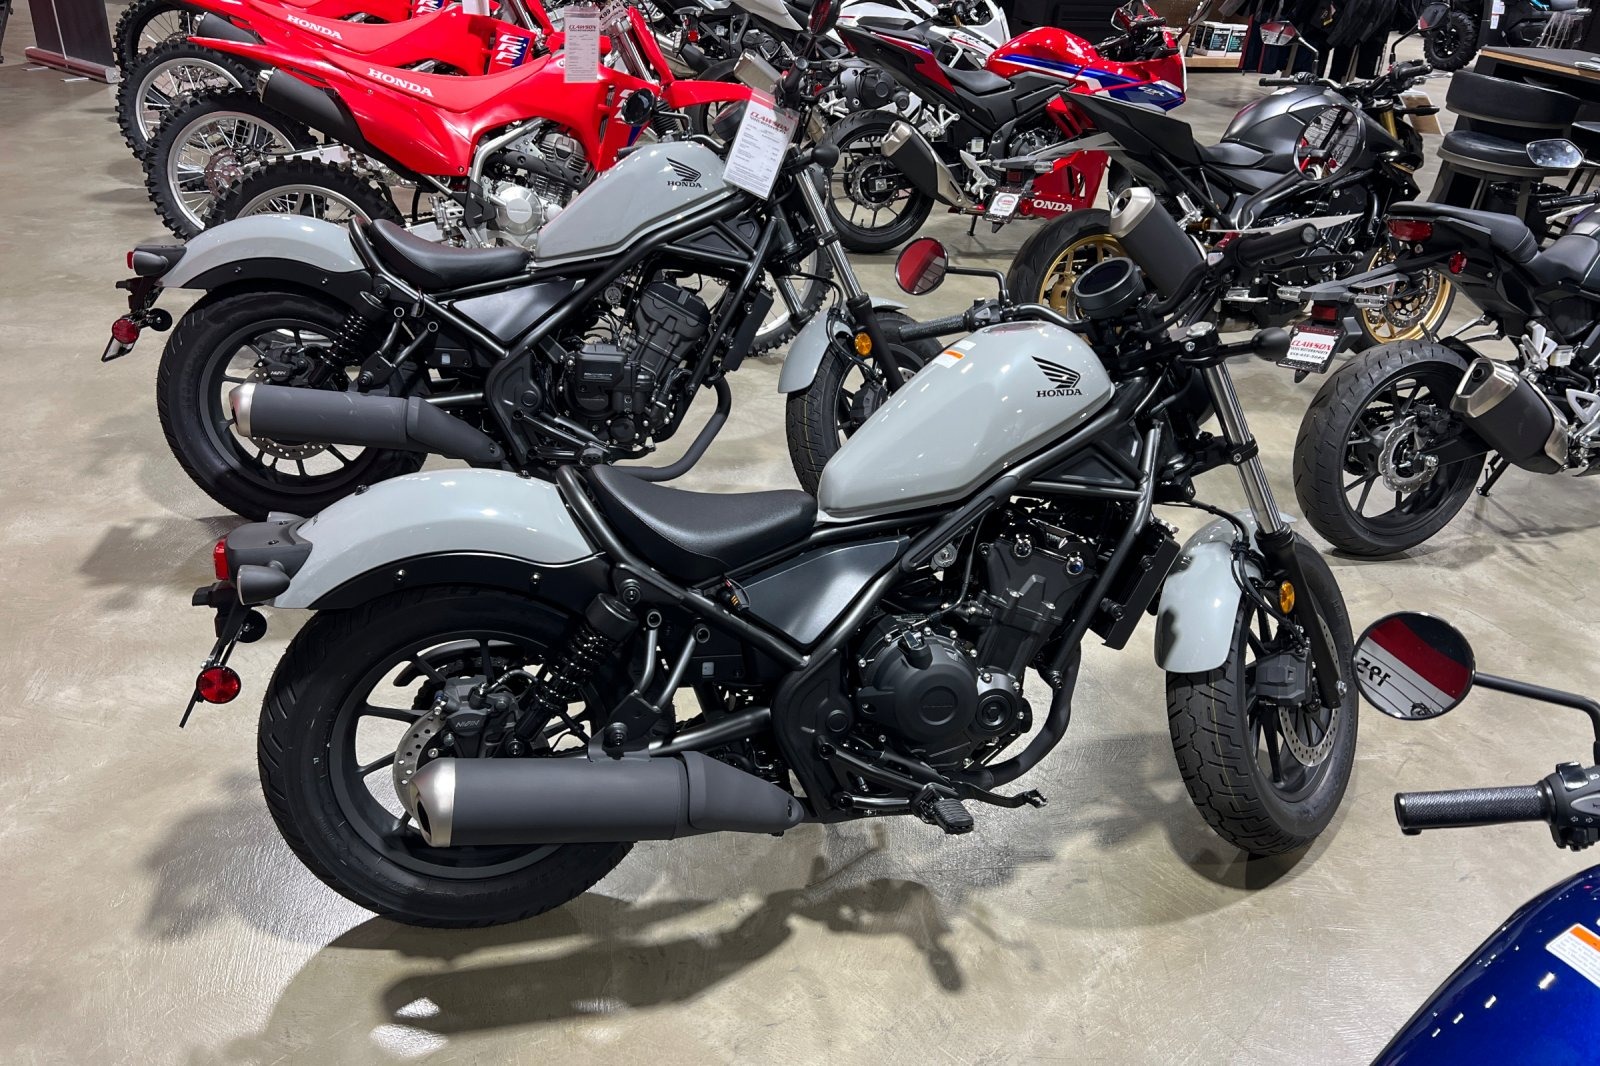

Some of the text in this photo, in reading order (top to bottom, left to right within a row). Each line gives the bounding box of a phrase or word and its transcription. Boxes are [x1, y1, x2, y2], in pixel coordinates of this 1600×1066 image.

[287, 14, 343, 40] HONDA
[495, 34, 525, 61] CRF
[367, 67, 434, 98] HONDA
[750, 111, 789, 132] CLAWSON
[667, 180, 702, 188] HONDA
[1031, 198, 1073, 213] ONDA
[1291, 340, 1333, 351] CLAWSON
[1036, 388, 1082, 397] HONDA
